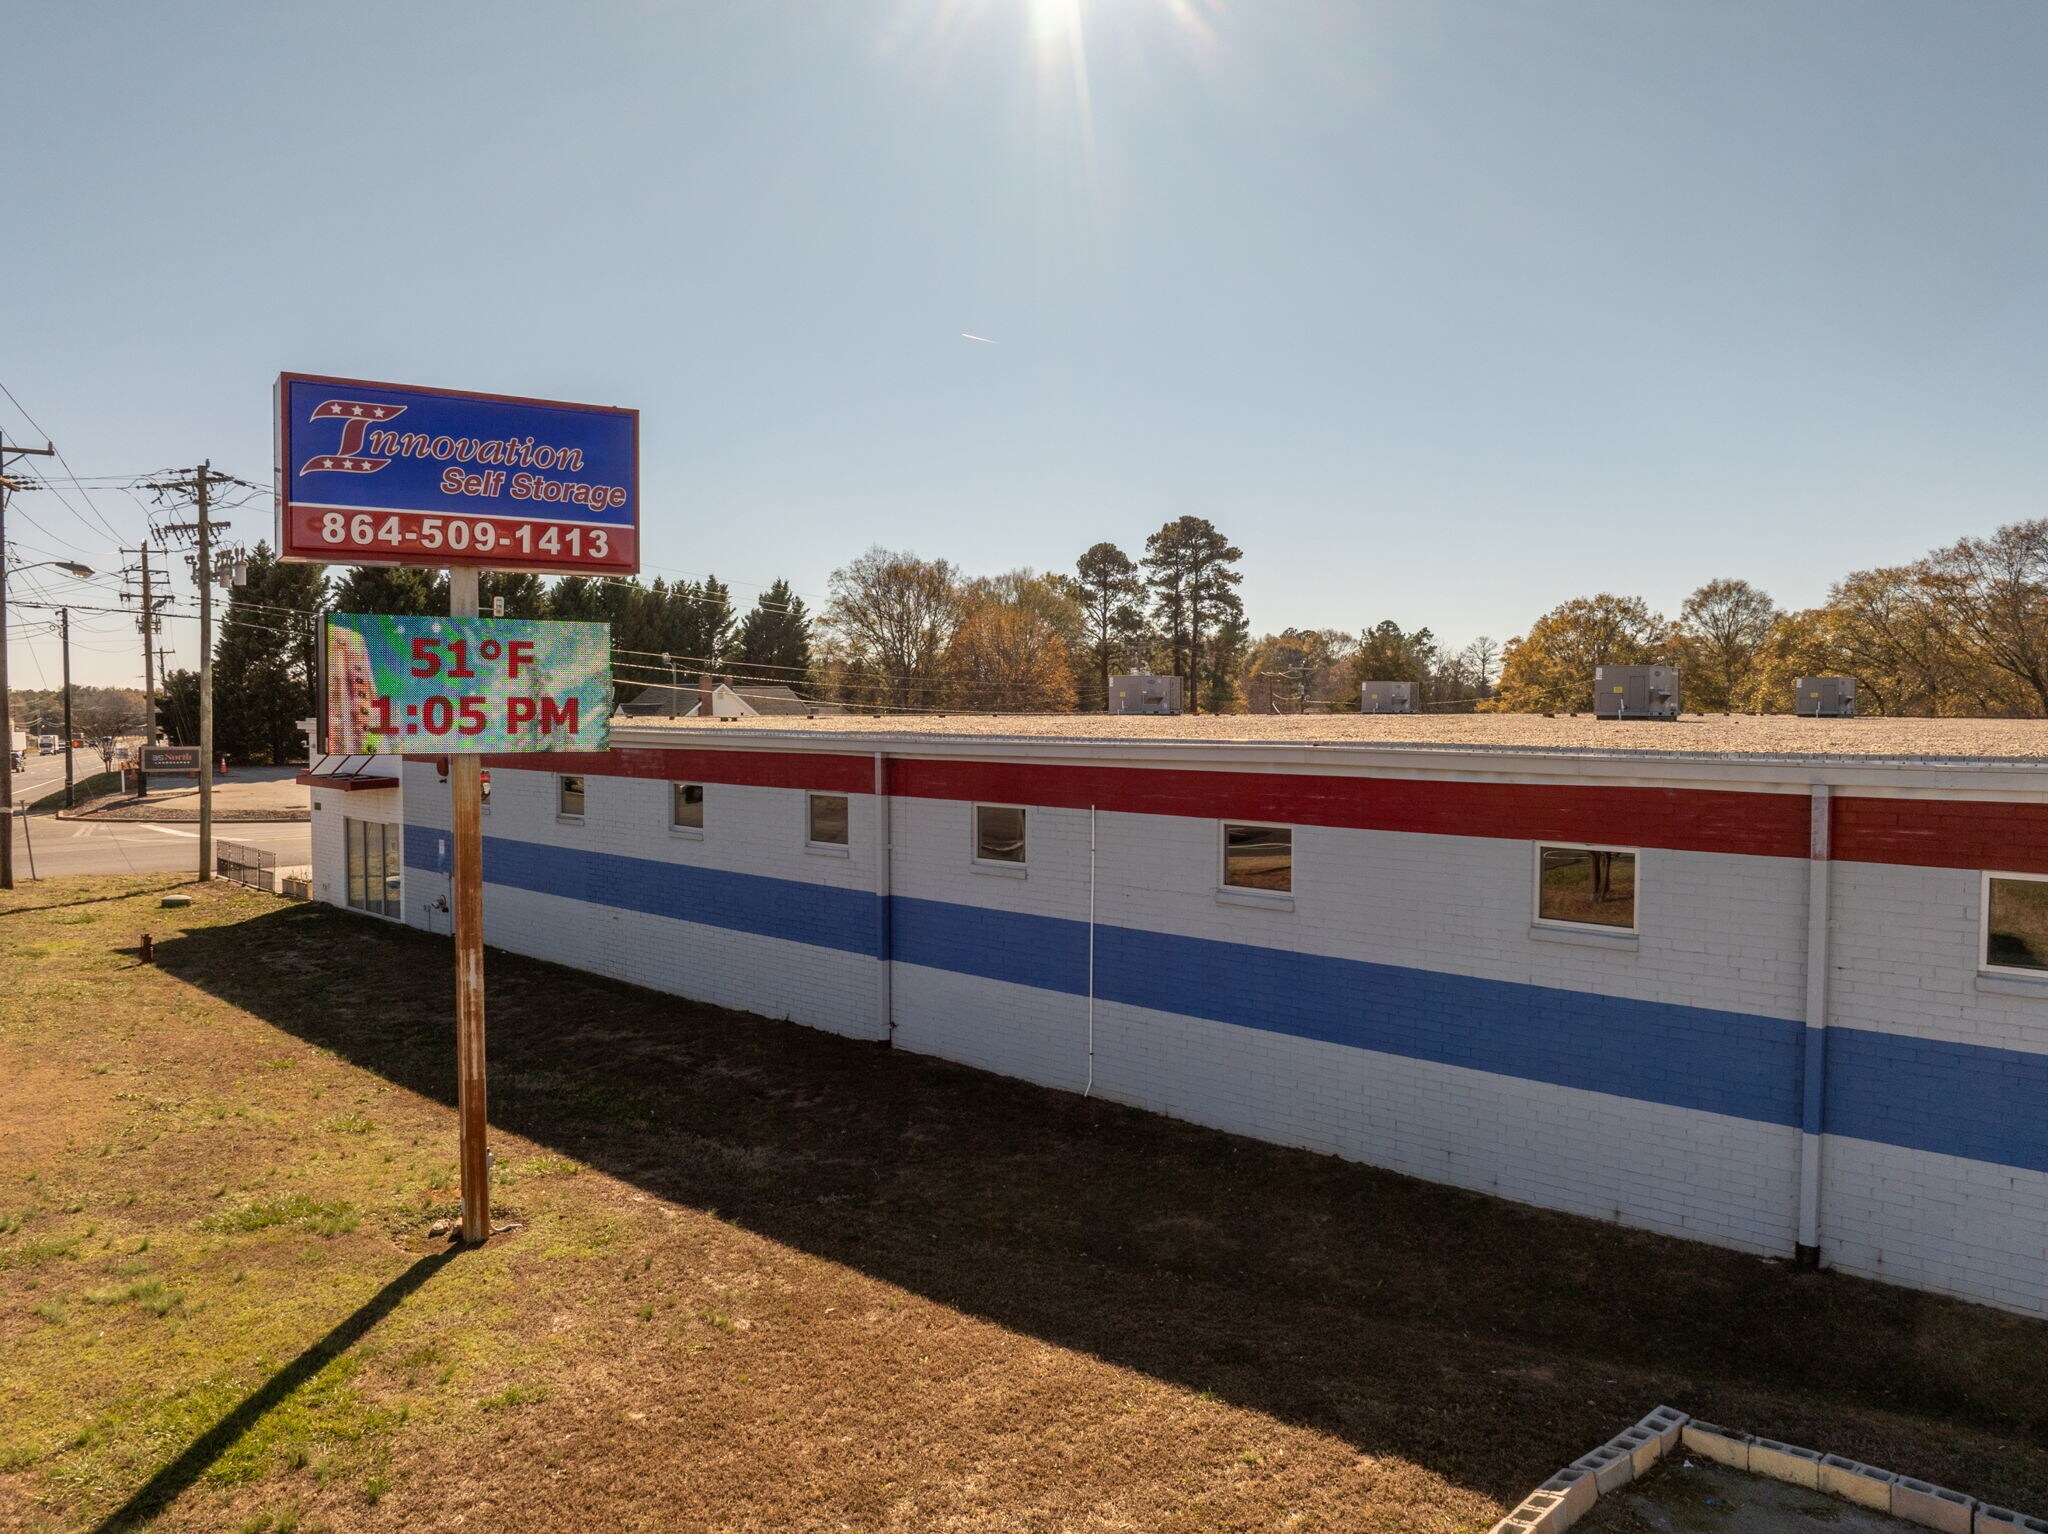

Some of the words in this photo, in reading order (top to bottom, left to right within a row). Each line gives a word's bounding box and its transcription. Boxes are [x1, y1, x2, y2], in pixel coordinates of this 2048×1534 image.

[300, 400, 584, 476] Innovation
[441, 467, 504, 497] Self
[510, 474, 626, 511] Storage
[321, 512, 608, 557] 864-509-1413
[411, 638, 534, 679] 51°F
[369, 696, 486, 735] 1:05
[506, 697, 579, 735] PM
